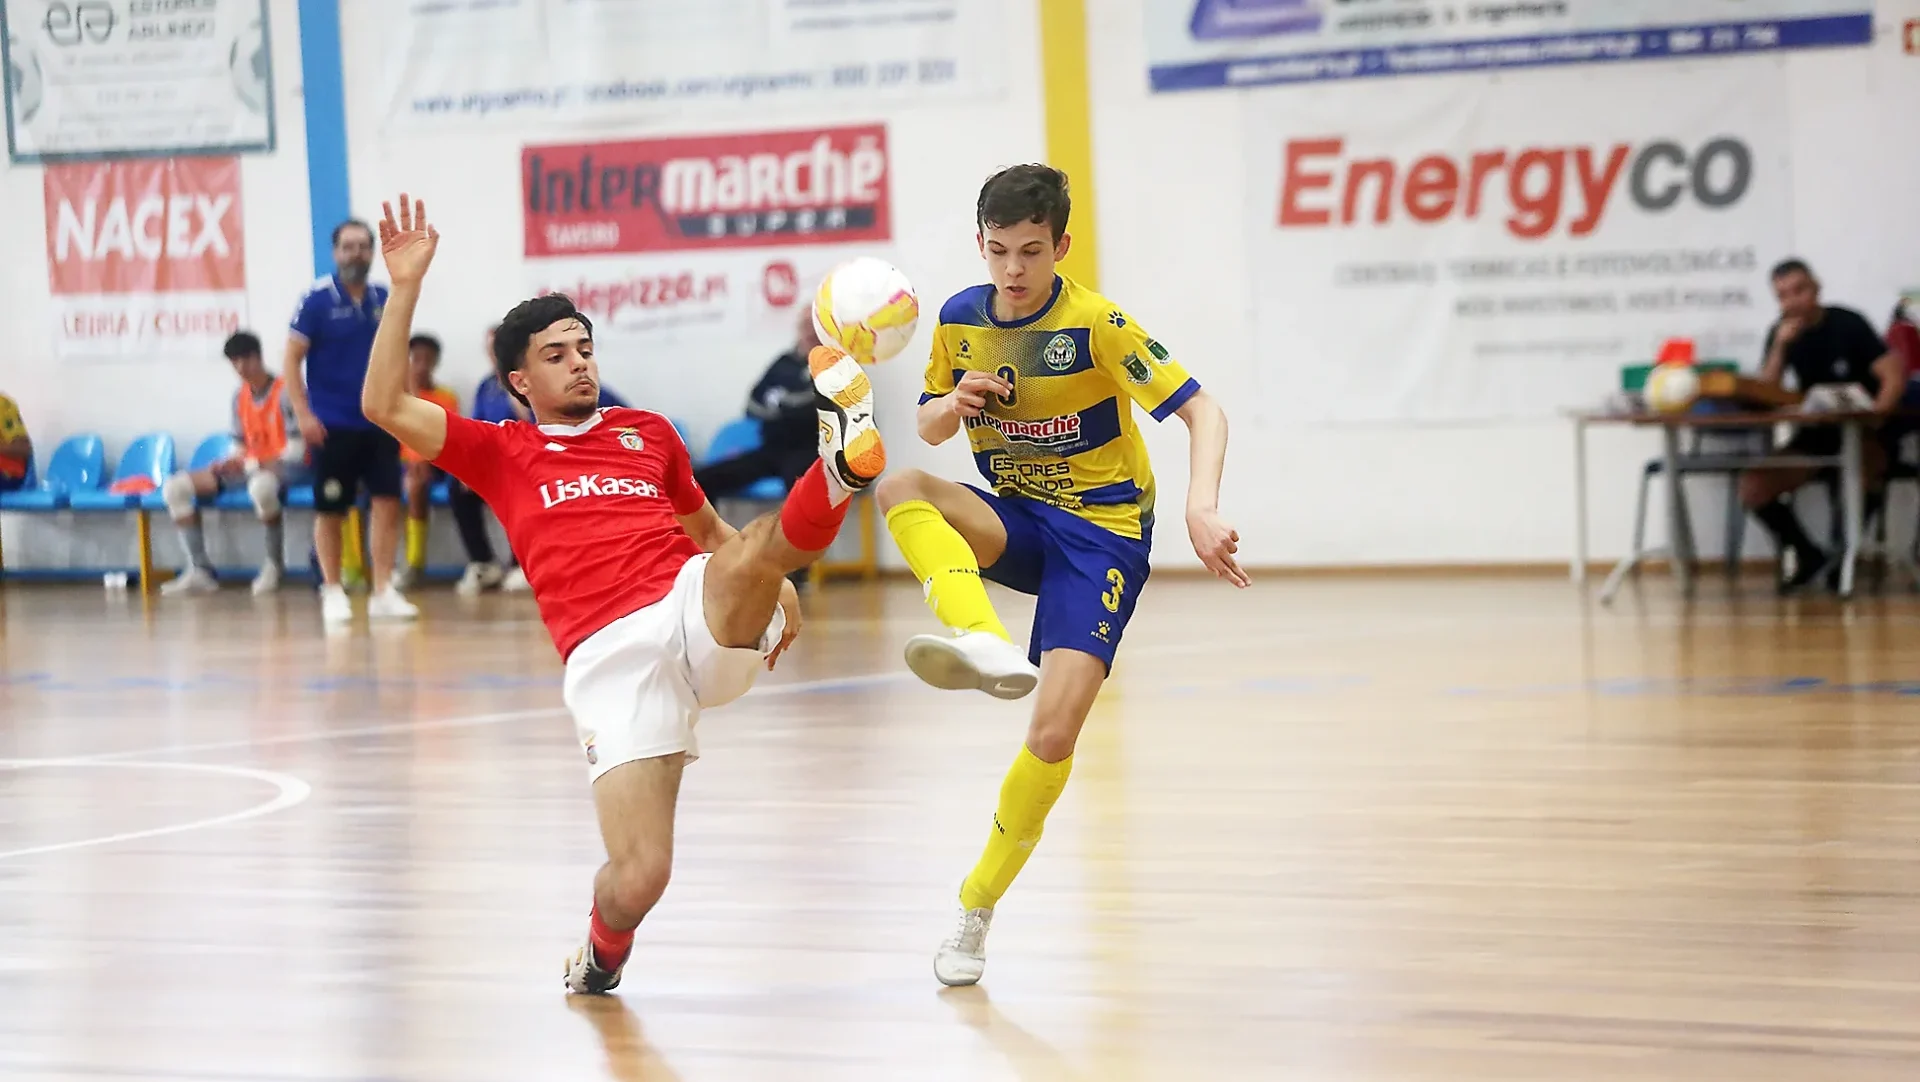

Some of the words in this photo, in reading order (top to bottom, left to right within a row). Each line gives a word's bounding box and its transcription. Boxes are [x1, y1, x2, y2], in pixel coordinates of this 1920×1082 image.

[1278, 137, 1753, 239] Energyco
[55, 193, 232, 261] NACEX
[540, 474, 658, 509] LisKasas
[1102, 567, 1125, 613] 3
